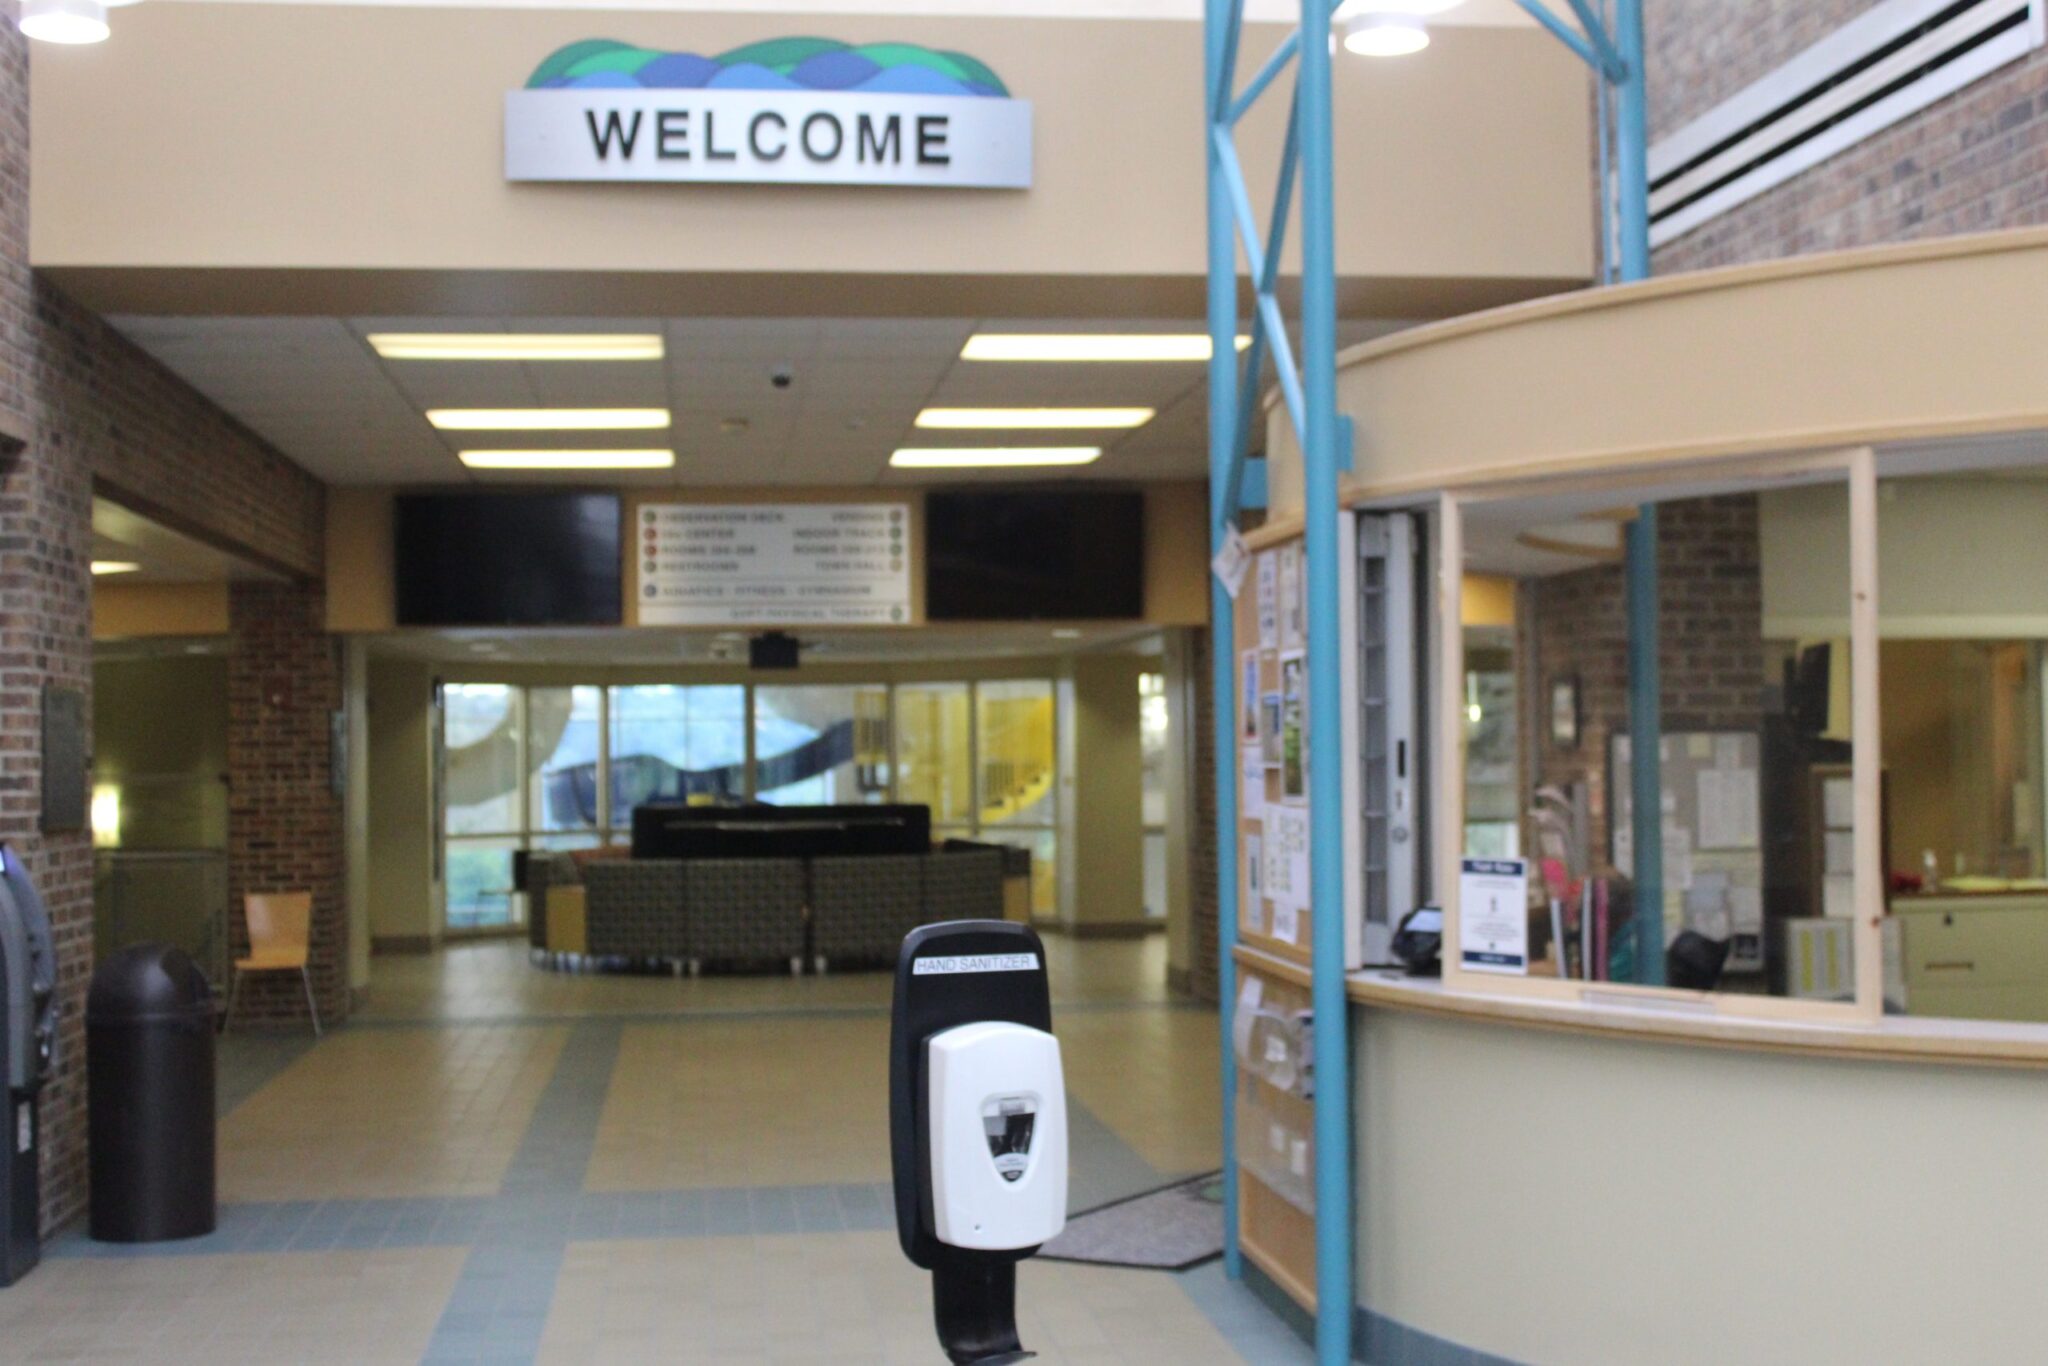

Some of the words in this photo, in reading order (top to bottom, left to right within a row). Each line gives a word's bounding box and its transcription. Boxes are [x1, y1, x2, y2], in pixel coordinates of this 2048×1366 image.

[585, 109, 951, 165] WELCOME
[916, 959, 956, 973] HAND
[959, 955, 1030, 971] SANITIZER
